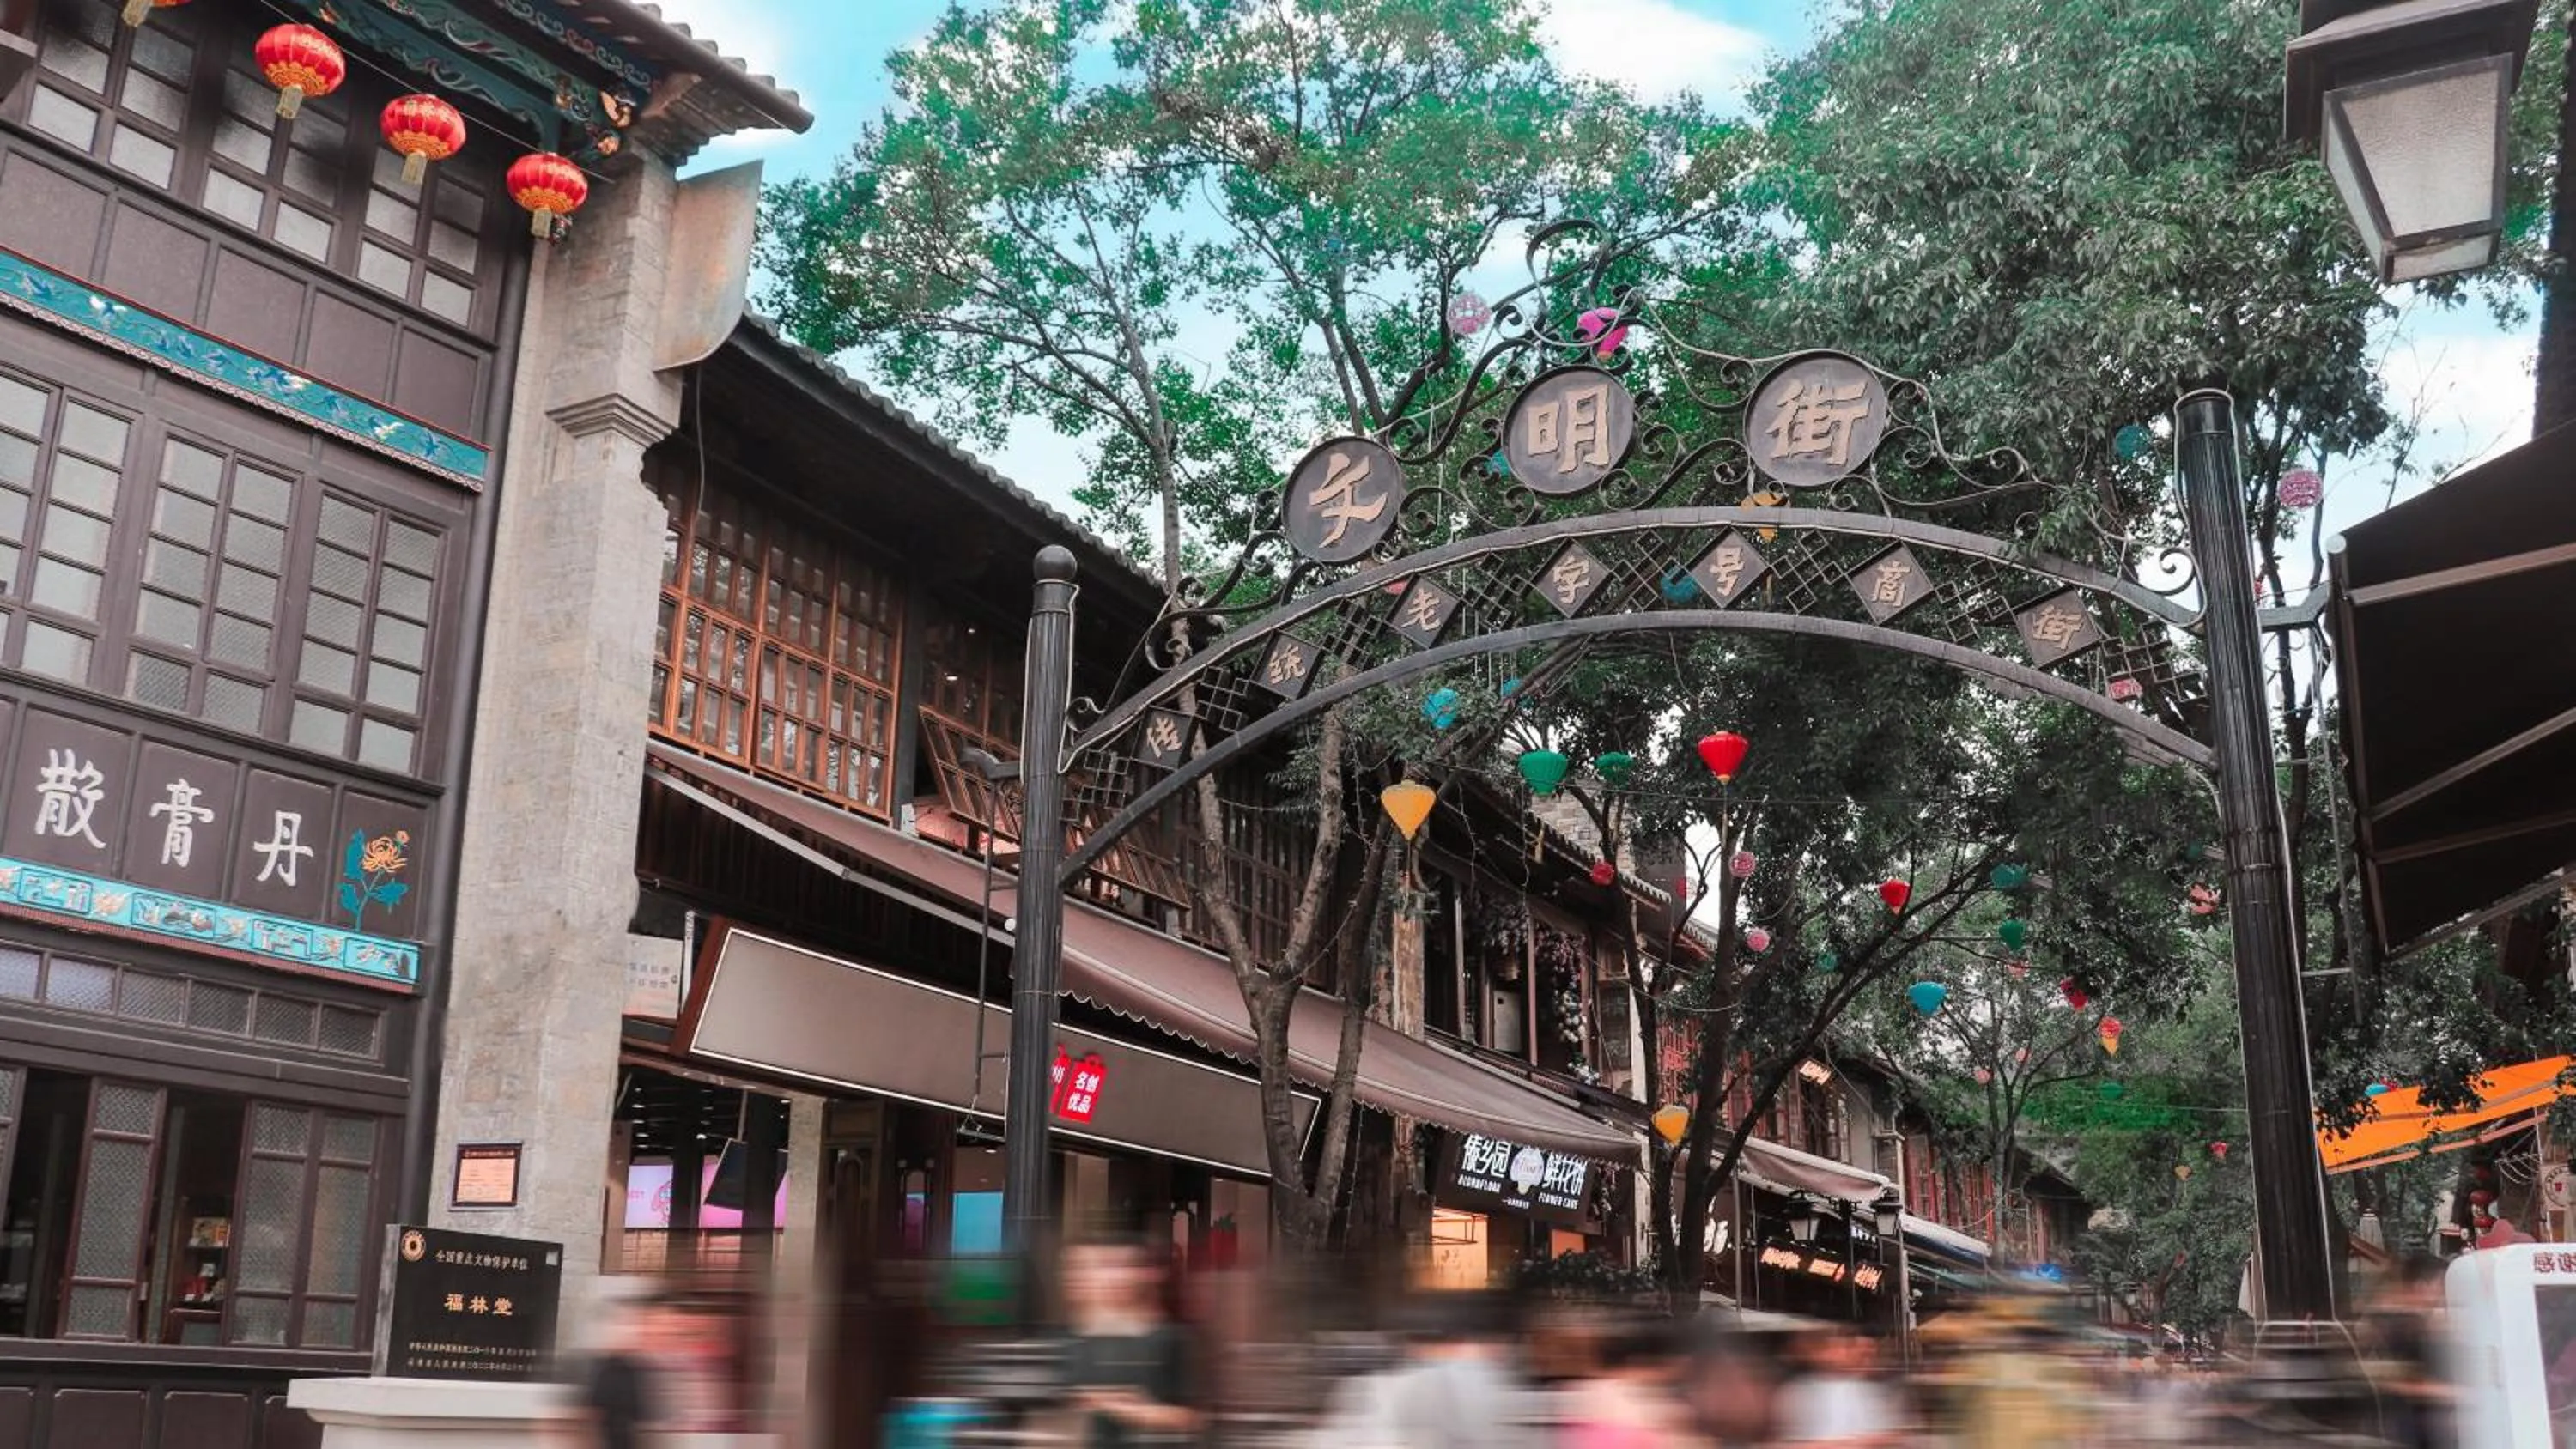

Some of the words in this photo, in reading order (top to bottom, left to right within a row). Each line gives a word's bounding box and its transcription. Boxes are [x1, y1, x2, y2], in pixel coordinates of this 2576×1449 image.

[1309, 382, 1871, 549] 文明街
[1074, 1070, 1100, 1094] 名创
[1067, 1092, 1091, 1114] 优品
[444, 1293, 513, 1316] 福林堂
